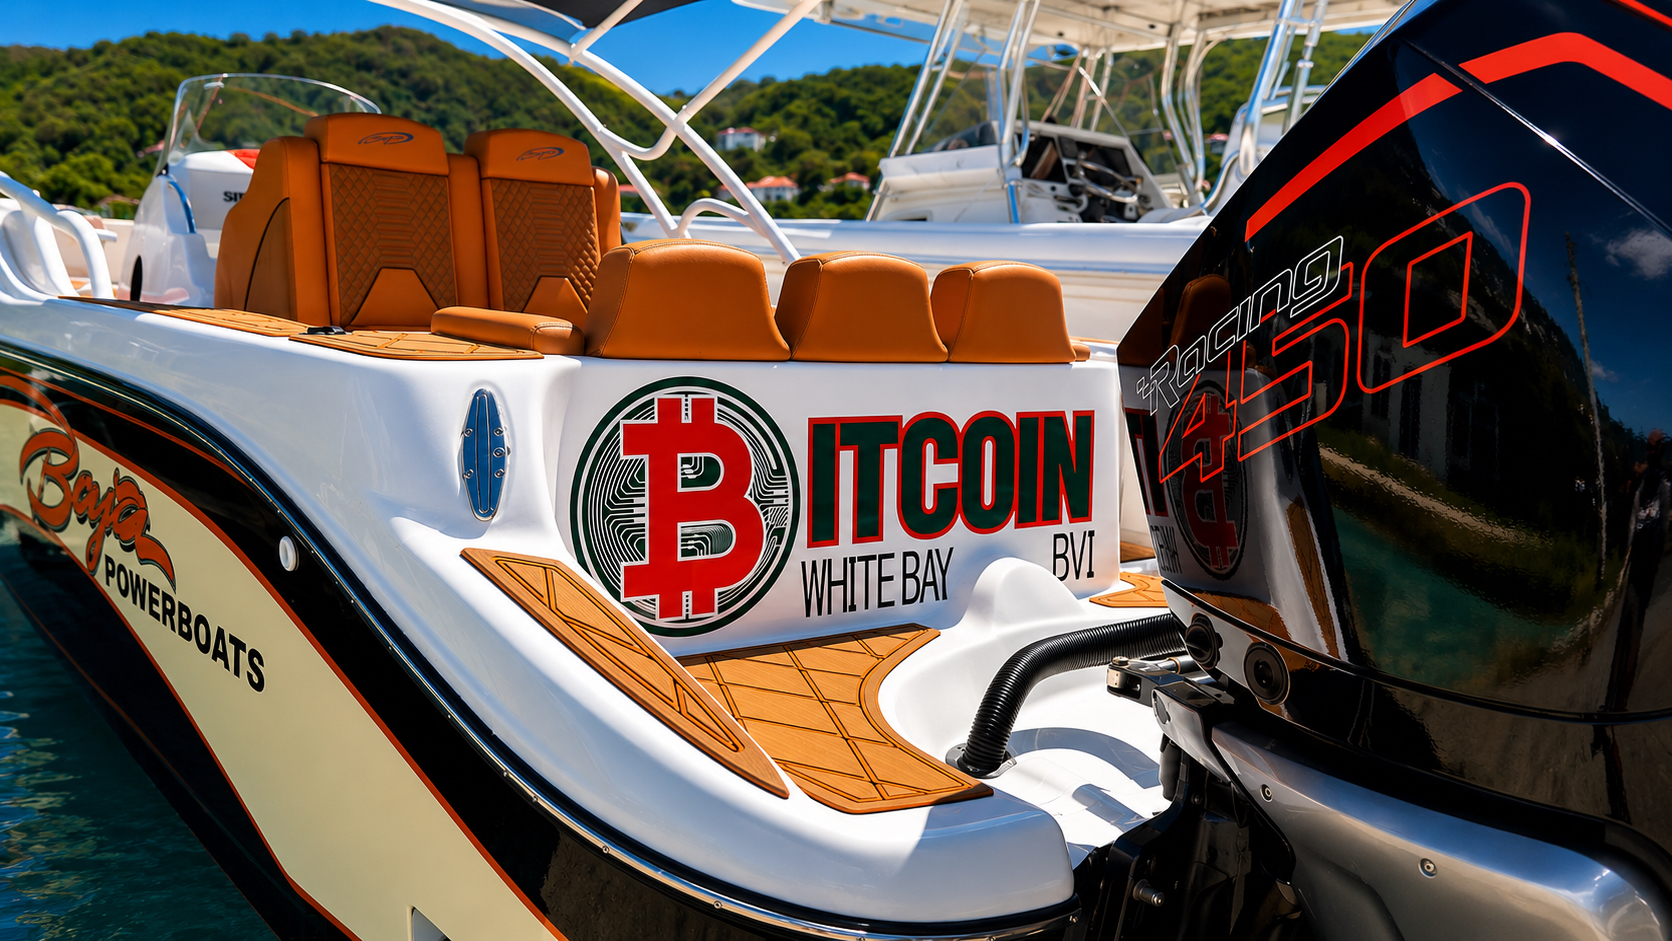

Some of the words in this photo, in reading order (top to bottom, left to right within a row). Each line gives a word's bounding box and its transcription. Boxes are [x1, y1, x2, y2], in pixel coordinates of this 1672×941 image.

[1159, 182, 1531, 483] 450
[19, 427, 177, 594] Baja
[1053, 530, 1095, 582] BVI
[104, 553, 265, 692] POWERBOATS
[801, 552, 895, 618] WHITE
[902, 547, 954, 606] BAY
